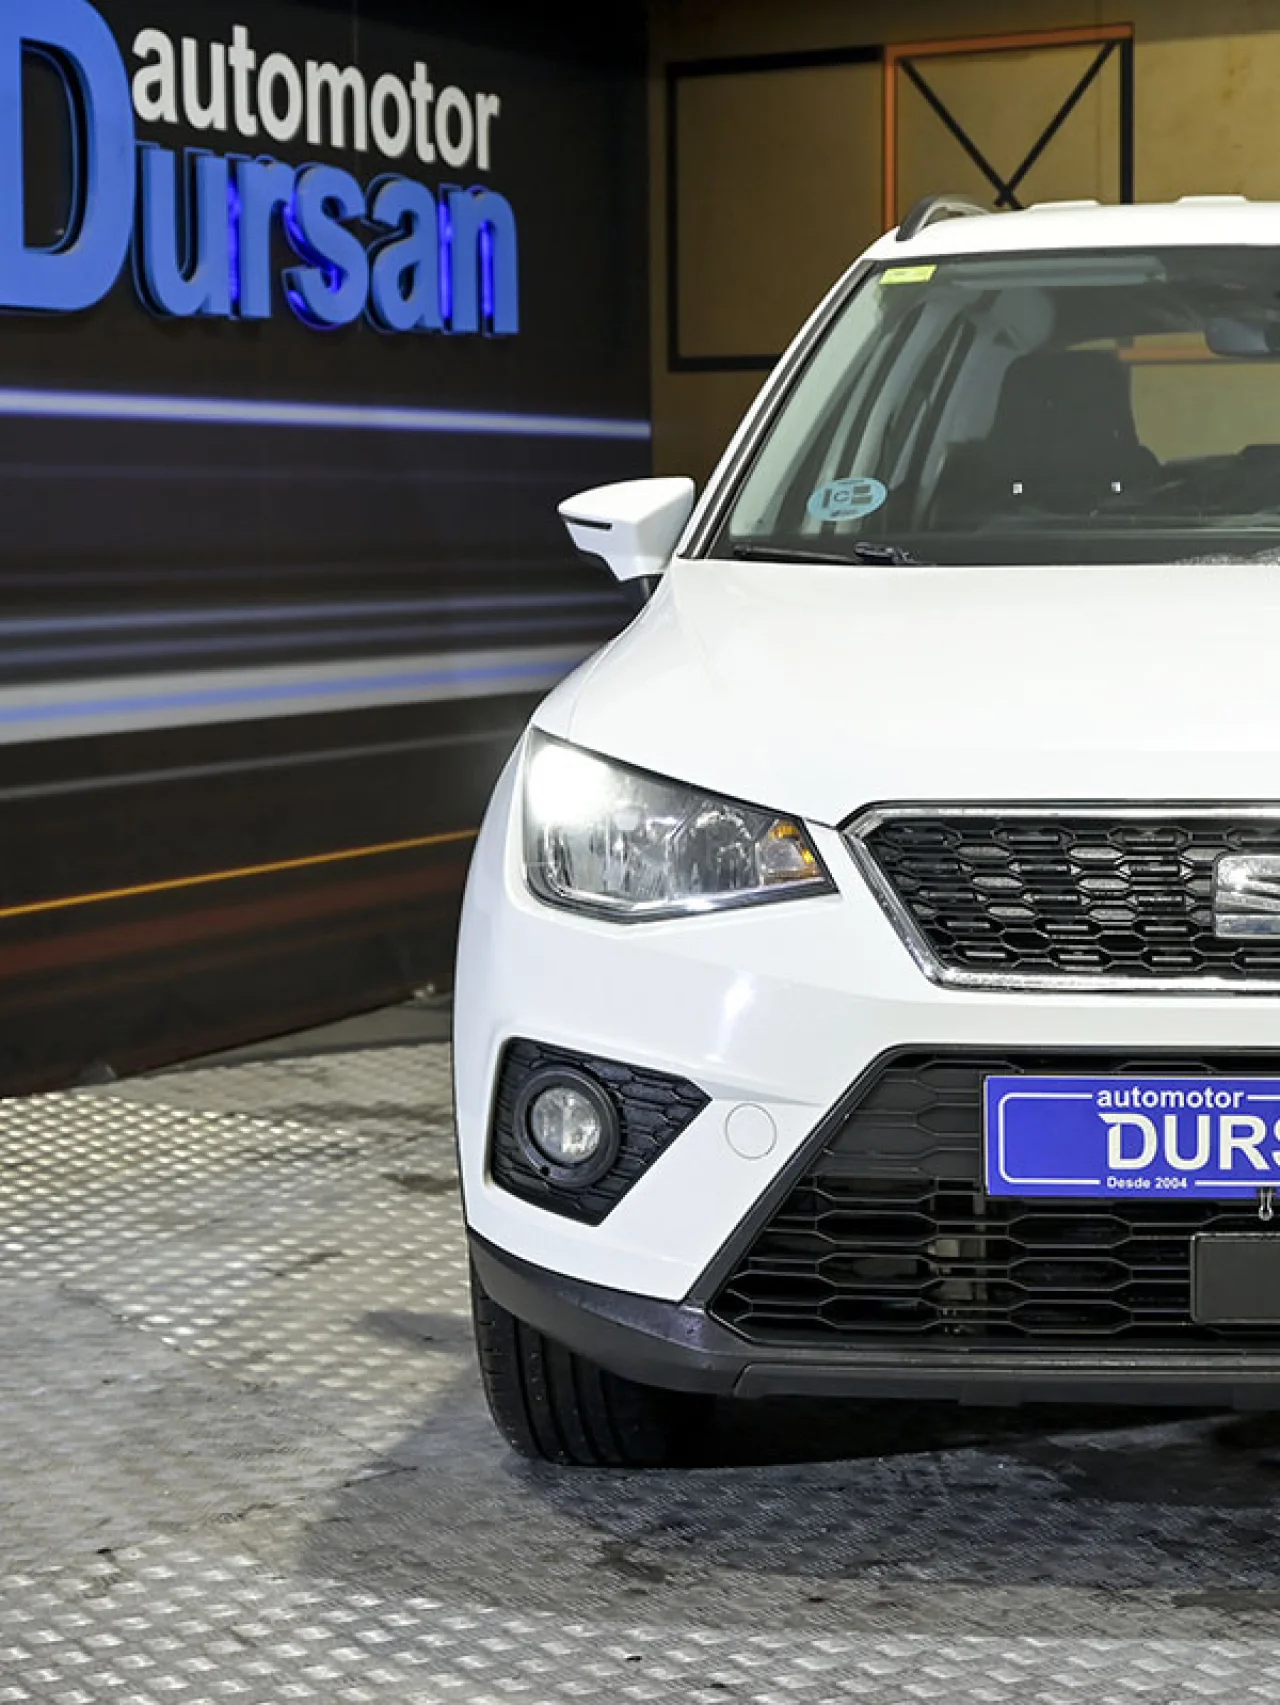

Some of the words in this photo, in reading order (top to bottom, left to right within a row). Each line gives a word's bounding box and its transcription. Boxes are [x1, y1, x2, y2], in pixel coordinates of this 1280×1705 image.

[131, 24, 500, 171] automotor
[0, 0, 519, 337] Dursan
[1096, 1086, 1245, 1110] automotor
[1106, 1175, 1151, 1190] Desde
[1155, 1176, 1188, 1190] 2004
